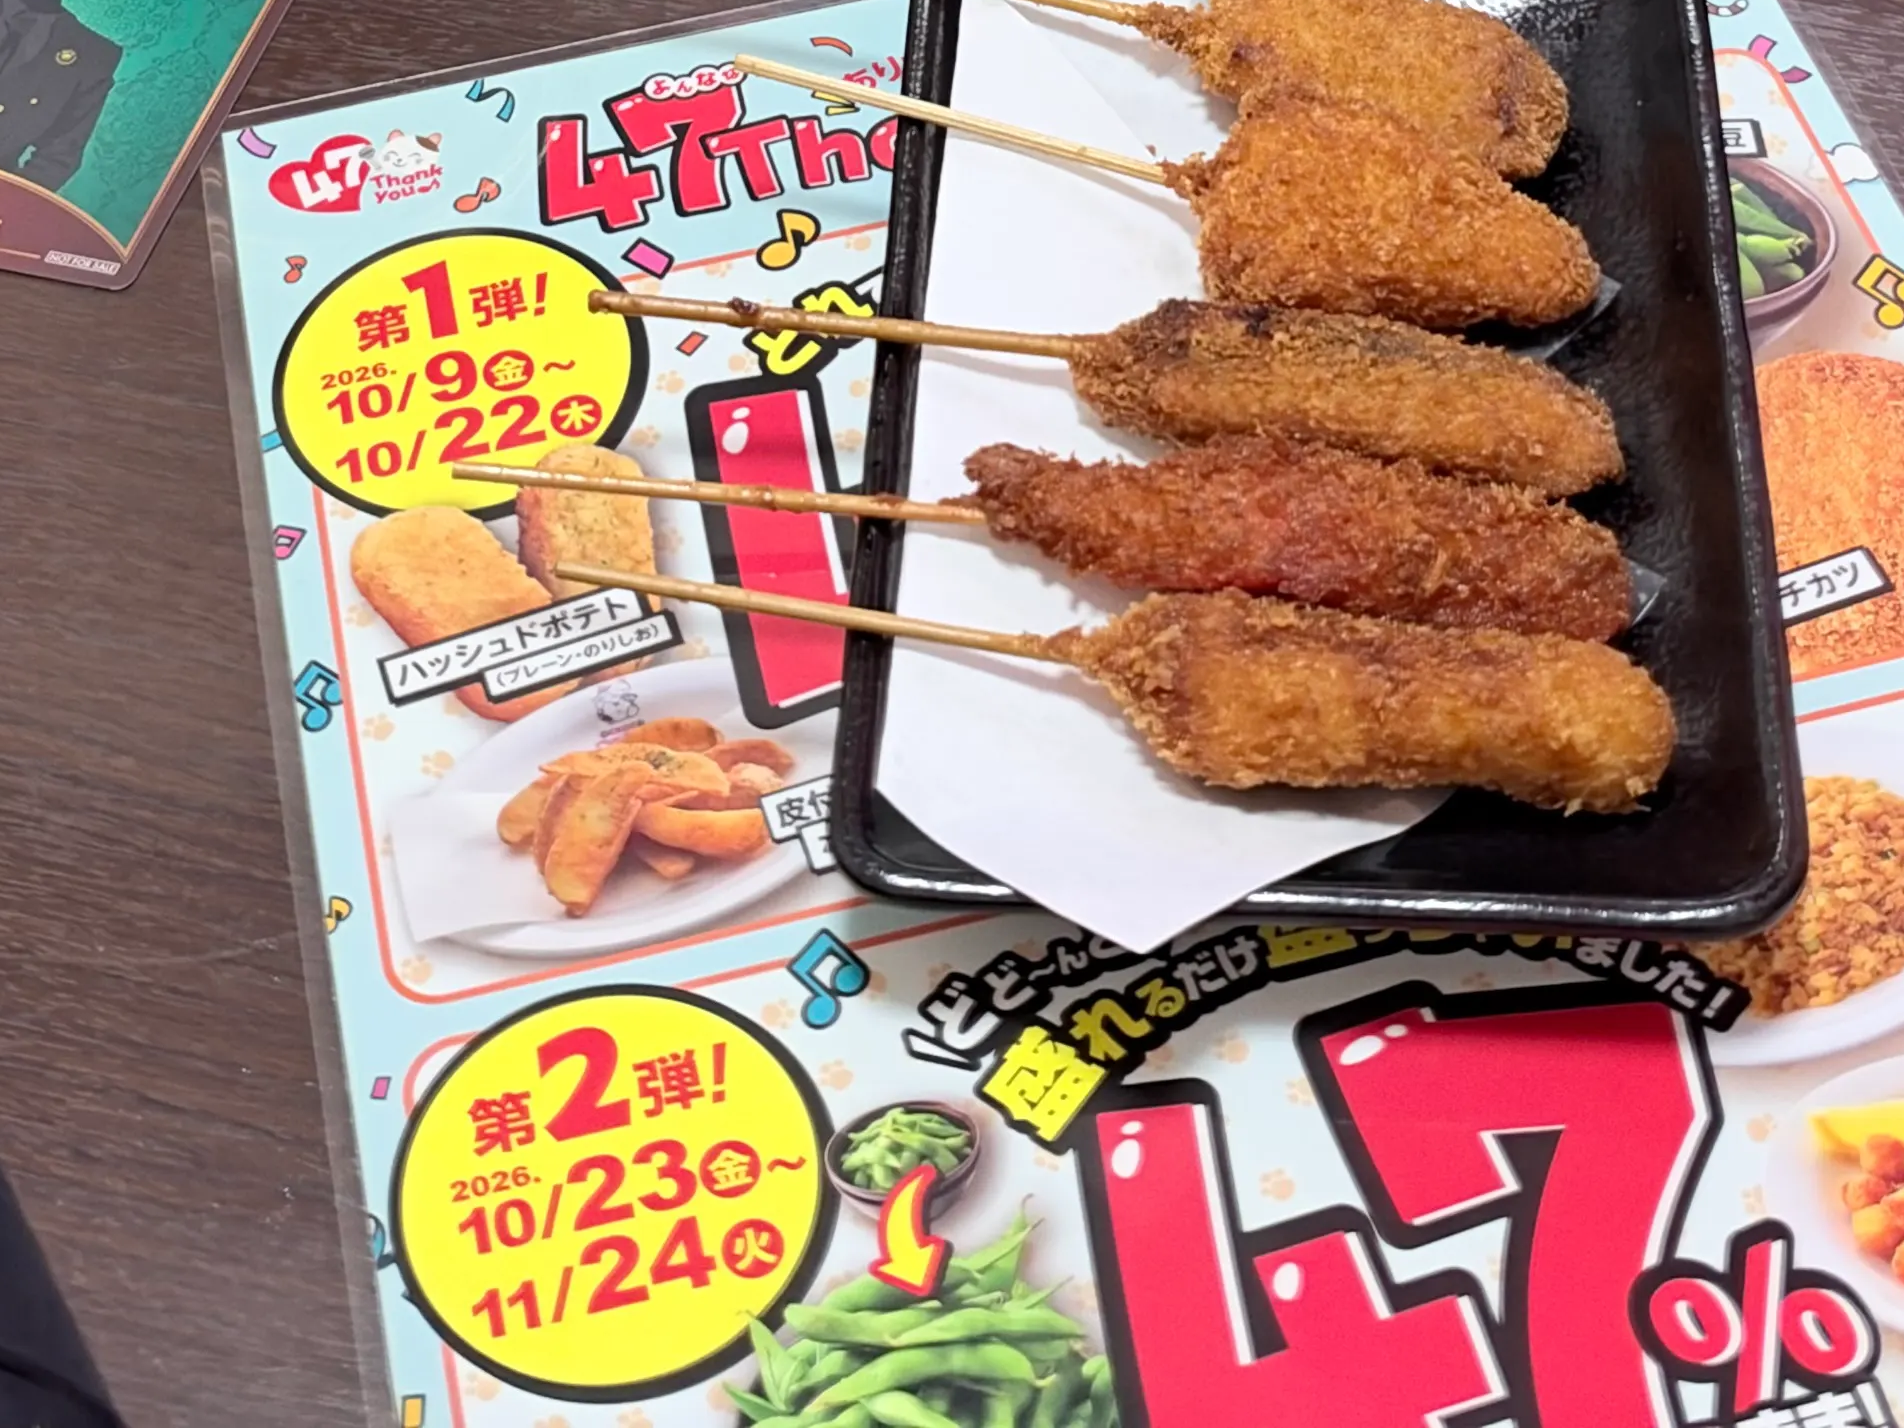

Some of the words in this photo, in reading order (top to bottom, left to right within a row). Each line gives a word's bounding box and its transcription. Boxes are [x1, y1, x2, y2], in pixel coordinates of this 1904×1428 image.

[294, 149, 370, 206] 47
[369, 163, 444, 188] Thank
[374, 181, 420, 204] you
[353, 260, 551, 354] 第1弾!
[321, 361, 398, 391] 2026.
[396, 596, 630, 688] ハッシュドポテト
[467, 1026, 729, 1158] 第2弾!
[449, 1170, 542, 1204] 2026.
